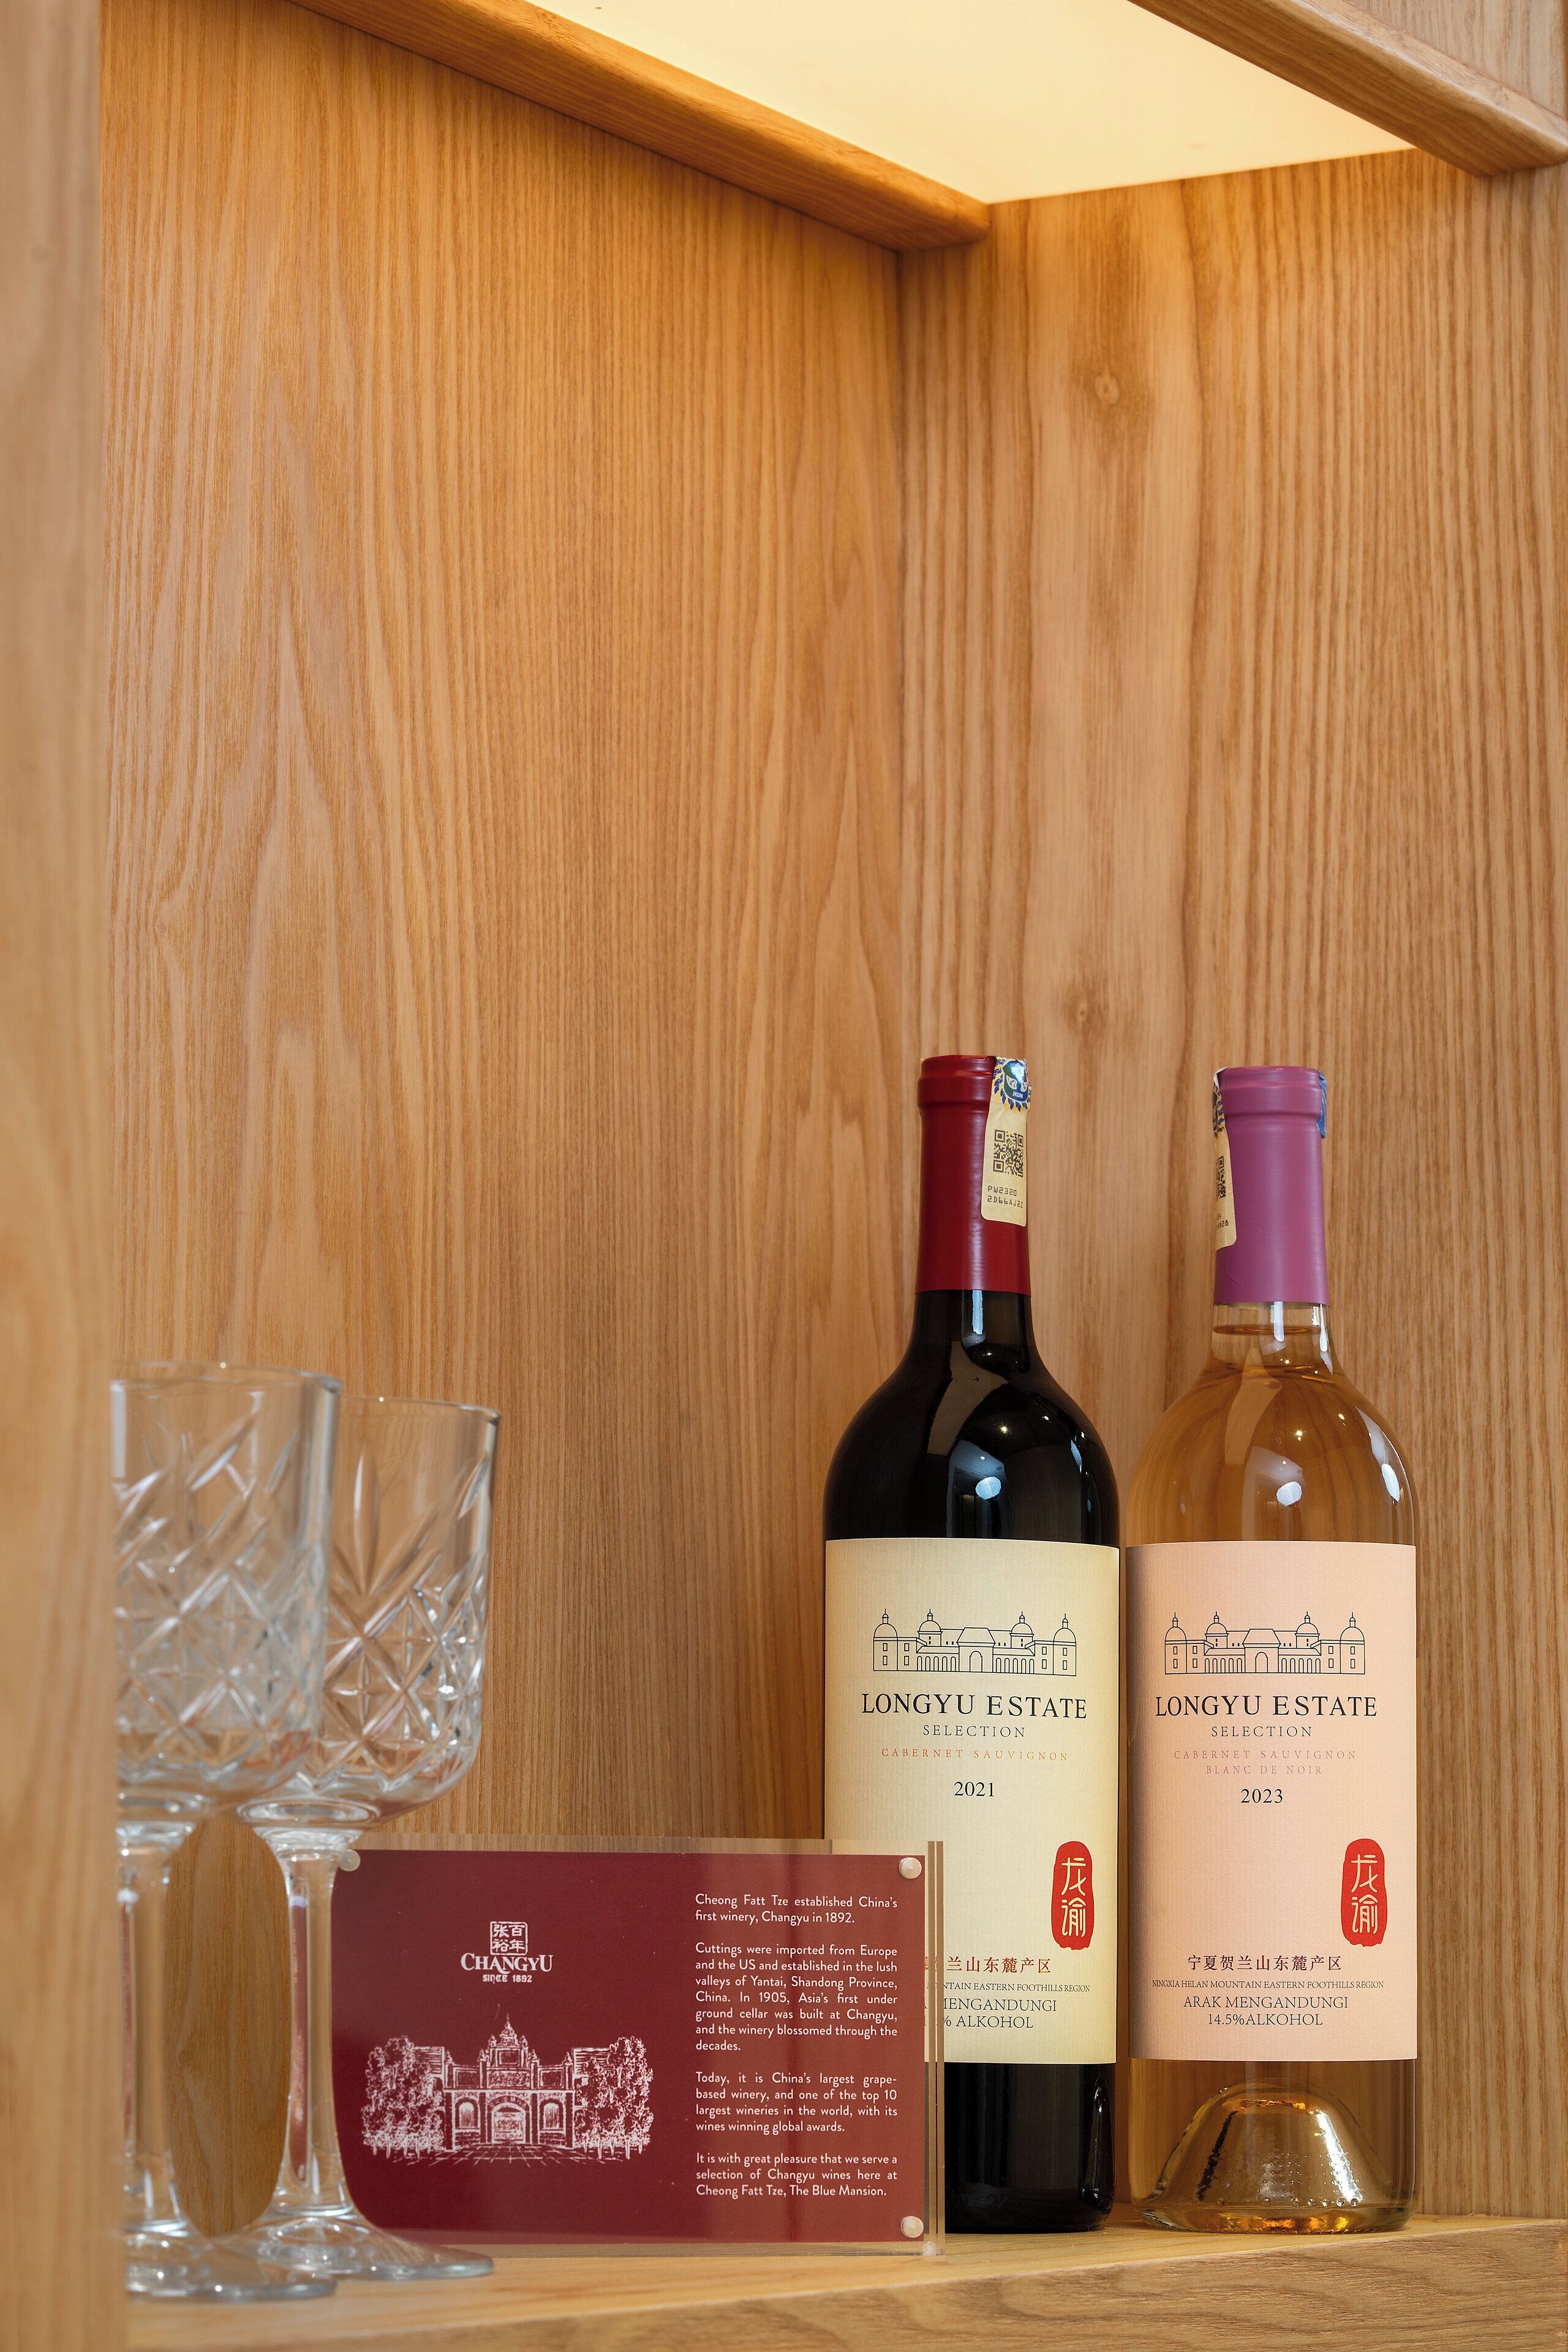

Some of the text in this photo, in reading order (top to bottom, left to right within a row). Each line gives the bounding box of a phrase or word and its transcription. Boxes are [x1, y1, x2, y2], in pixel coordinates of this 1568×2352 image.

[861, 1693, 1087, 1719] LONGYU ESTATE
[1155, 1695, 1378, 1717] LONGYU ESTATE
[922, 1724, 1025, 1738] SELECTION
[1211, 1725, 1312, 1738] SELECTION
[881, 1748, 1067, 1761] CABERNET SAUVIGNON
[1174, 1750, 1355, 1760] CABERNET SAUVIGNON
[1206, 1765, 1322, 1774] BLANC DE NOIR
[954, 1781, 995, 1797] 2021
[1240, 1789, 1283, 1804] 2023
[695, 1893, 898, 1909] Cheong Fatt Tze established China’s
[695, 1909, 855, 1926] first winery, Changyu in 1892.
[695, 1942, 742, 1958] Cuttings
[776, 1943, 824, 1959] imported
[829, 1943, 855, 1956] from
[860, 1944, 898, 1960] Europe
[461, 1953, 554, 1974] CHANGYU
[695, 1958, 897, 1972] and the US and established in the lush
[925, 1956, 1051, 1974] 兰山东麓产区
[1187, 1954, 1341, 1972] 宁夏贺兰山东麓产区
[695, 1974, 897, 1992] valleys of Yantai, Shandong Province,
[973, 1983, 1015, 1991] EASTERN
[1016, 1983, 1063, 1992] FOOTHILLS
[1210, 1980, 1262, 1989] MOUNTAIN
[1355, 1980, 1384, 1989] REGION
[695, 1990, 898, 2005] China. In 1905, Asia’s first under
[1183, 1996, 1348, 2009] ARAK MENGANDUNGI
[695, 2007, 733, 2022] ground
[739, 2007, 769, 2019] cellar
[799, 2008, 824, 2019] built
[829, 2010, 840, 2019] at
[846, 2008, 897, 2024] Changyu,
[955, 2015, 1034, 2029] ALKOHOL
[695, 2022, 898, 2040] and the winery blossomed through the
[695, 2039, 741, 2051] decades.
[695, 2071, 897, 2088] Today, it is China’s largest grape-
[696, 2087, 726, 2099] based
[731, 2088, 770, 2103] winery,
[774, 2088, 794, 2100] and
[823, 2088, 835, 2100] of
[839, 2089, 857, 2100] the
[861, 2091, 880, 2105] top
[884, 2089, 897, 2100] 10
[696, 2103, 898, 2119] largest wineries in the world, with its
[696, 2120, 845, 2136] wines winning global awards.
[696, 2152, 704, 2163] It
[707, 2152, 715, 2163] is
[717, 2152, 741, 2163] with
[744, 2154, 771, 2168] great
[774, 2152, 818, 2168] pleasure
[820, 2152, 842, 2164] that
[696, 2168, 898, 2184] selection of Changyu wines here at
[696, 2184, 887, 2200] Cheong Fatt Tze, The Blue Mansion.
